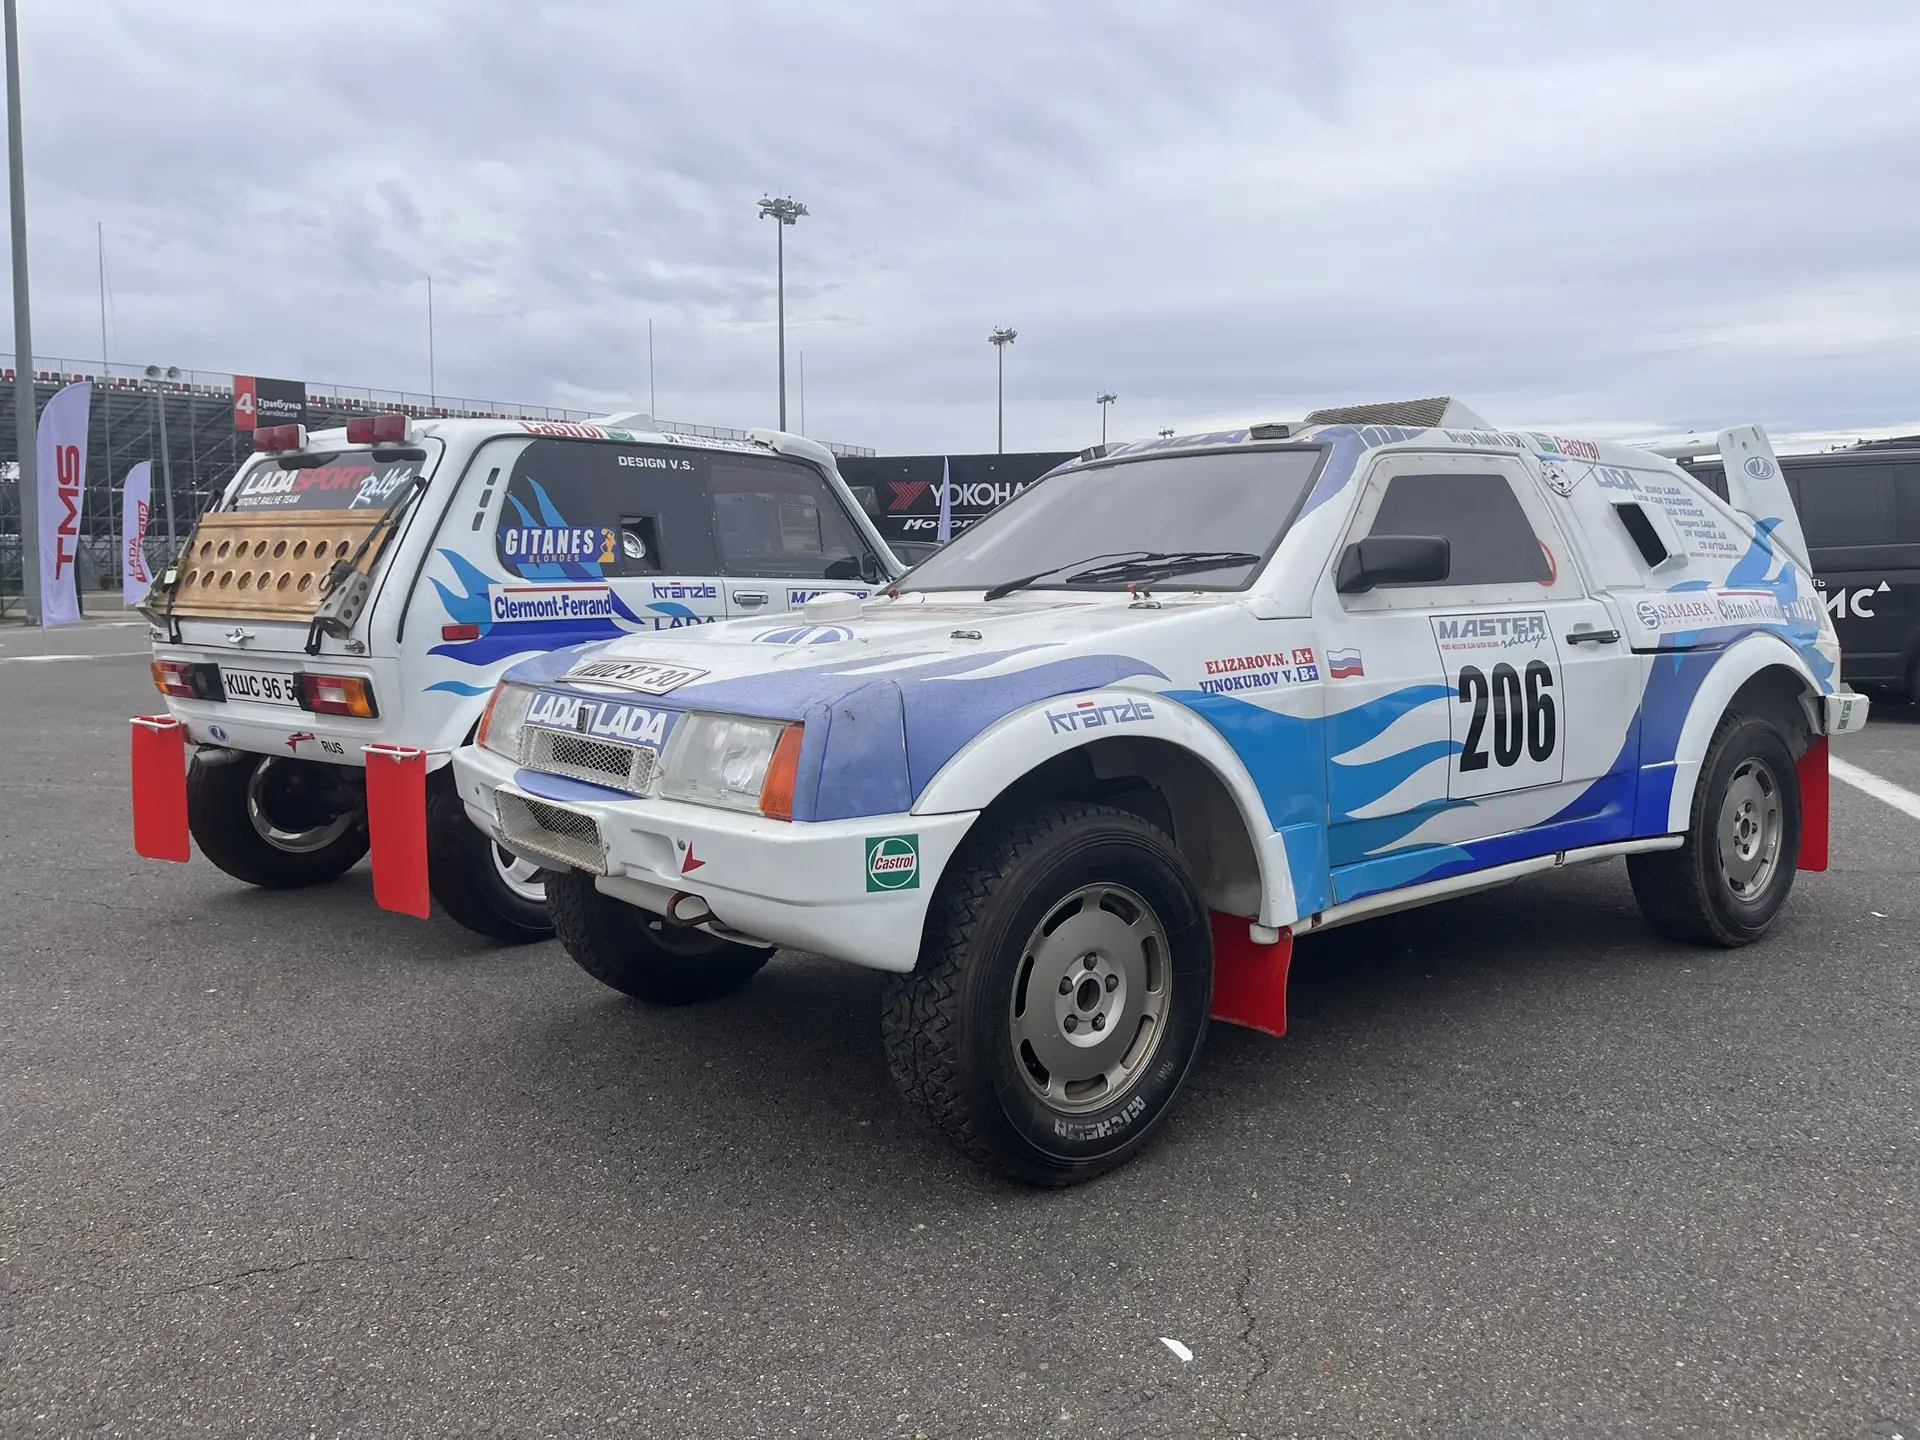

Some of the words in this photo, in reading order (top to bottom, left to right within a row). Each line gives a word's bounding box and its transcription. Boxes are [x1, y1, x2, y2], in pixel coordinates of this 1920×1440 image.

[236, 393, 254, 415] 4
[256, 398, 302, 411] Трибуна
[257, 408, 298, 418] Grandstand
[1554, 436, 1601, 460] Castrol
[618, 455, 667, 470] DESIGN
[669, 458, 695, 471] V.S.
[1587, 466, 1642, 492] LADA
[55, 444, 80, 580] TMS
[1665, 507, 1678, 516] ADA
[1679, 508, 1705, 517] FRANCE
[505, 528, 594, 555] GITANES
[128, 538, 138, 577] LADA
[528, 554, 580, 563] BLONDES
[494, 594, 613, 619] Clermont-Ferrand
[1659, 602, 1714, 620] SAMARA
[1439, 616, 1544, 639] MASTER
[226, 674, 261, 697] КШС
[264, 677, 282, 699] 96
[648, 669, 690, 687] 30
[1199, 671, 1279, 694] VINOKUROV
[1281, 670, 1297, 684] V.
[592, 703, 667, 745] LADA
[1458, 659, 1556, 773] 206
[321, 739, 345, 755] RUS
[874, 855, 914, 870] Castrol
